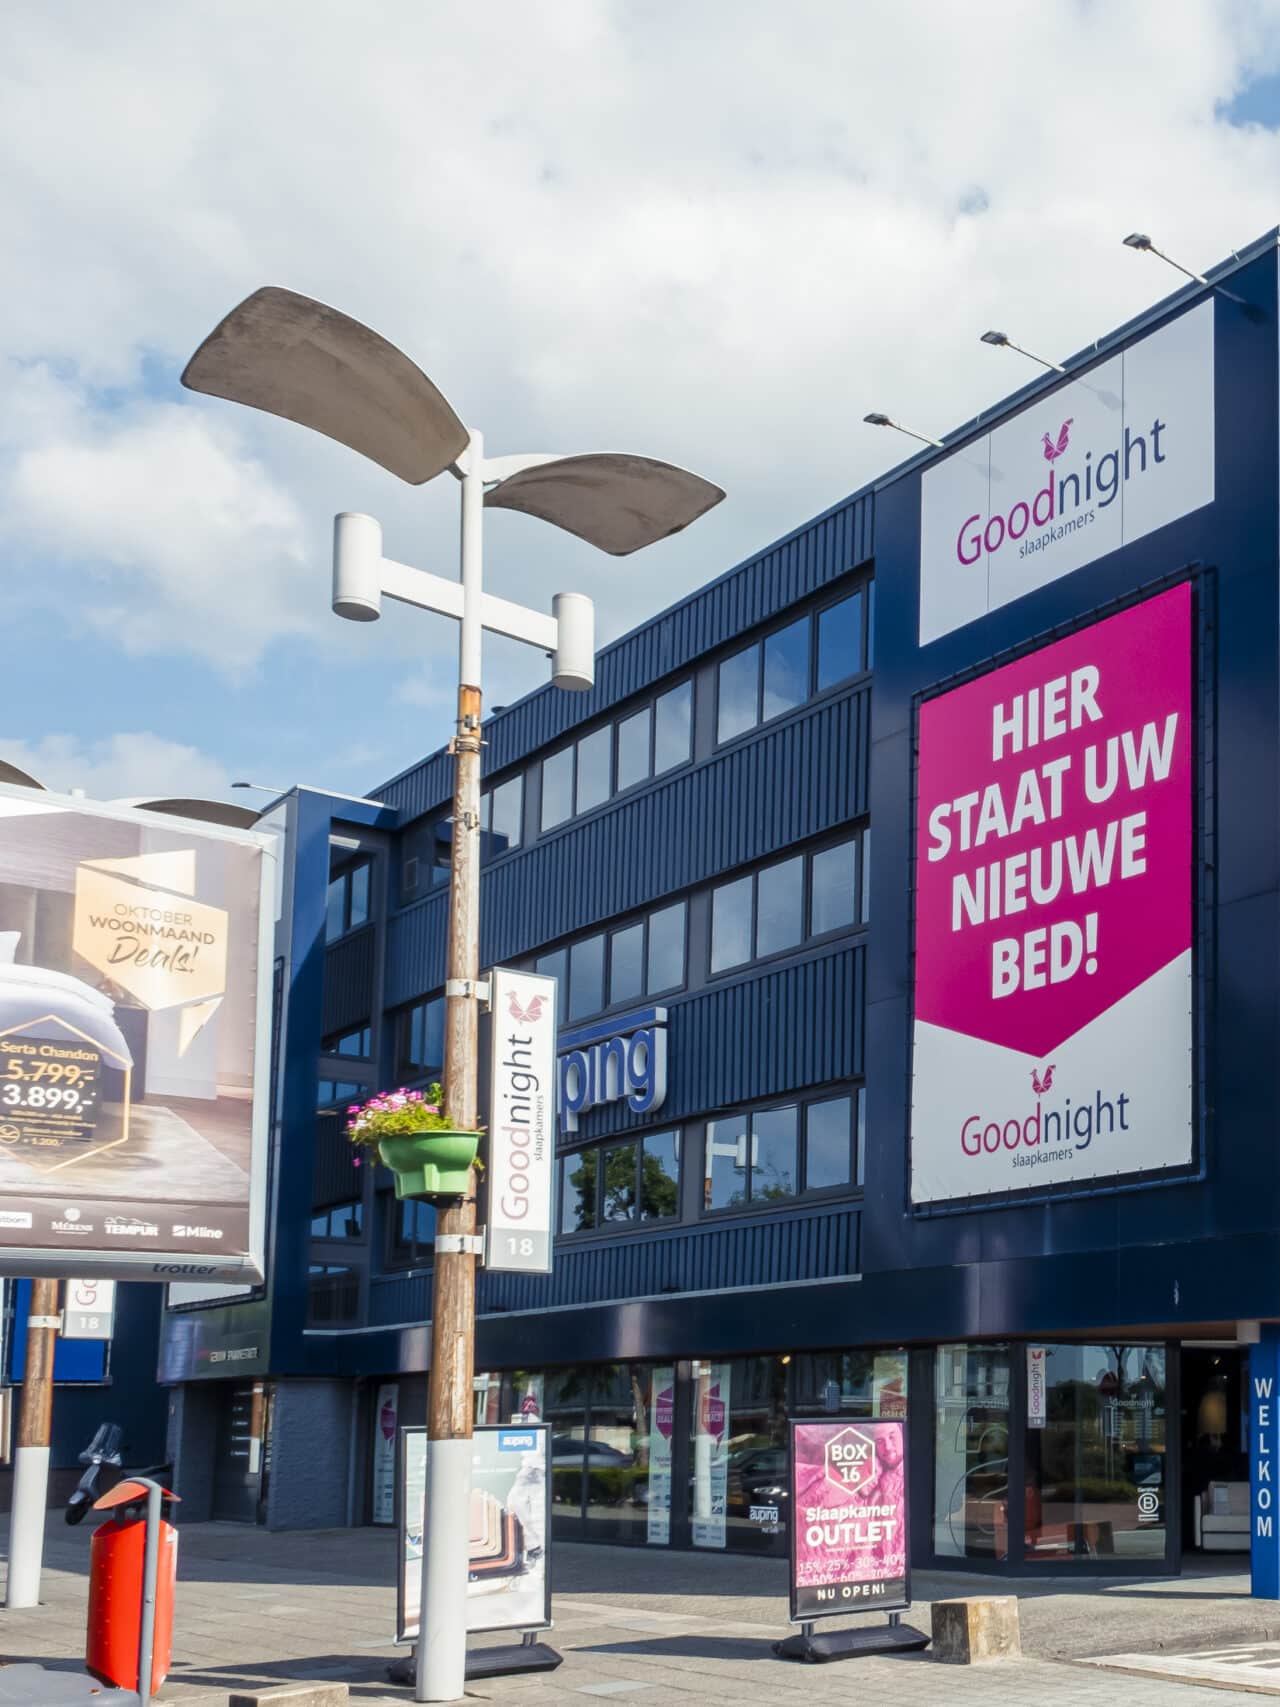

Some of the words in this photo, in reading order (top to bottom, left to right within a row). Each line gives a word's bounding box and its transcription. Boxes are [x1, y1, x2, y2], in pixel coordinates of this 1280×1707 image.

[957, 419, 1166, 566] Goodnight
[1019, 508, 1095, 559] slaapkamers
[992, 665, 1103, 761] HIER
[927, 754, 1071, 863] STAAT
[1084, 713, 1178, 805] UW
[951, 811, 1147, 932] NIEUWE
[113, 903, 193, 926] OKTOBER
[88, 914, 215, 945] WOONMAAND
[991, 913, 1099, 1000] BED!
[0, 1041, 37, 1055] Serta
[40, 1045, 99, 1062] Chandon
[501, 1034, 540, 1221] Goodnight
[534, 1094, 546, 1162] slaapkamers
[961, 1090, 1129, 1158] Goodnight
[1012, 1146, 1074, 1170] slaapkamers
[104, 1225, 159, 1237] TEMPUR
[186, 1226, 224, 1240] Mline
[506, 1237, 533, 1256] 18
[152, 1263, 217, 1276] trotter
[80, 1316, 99, 1330] 18
[831, 1444, 868, 1461] BOX
[1254, 1378, 1273, 1538] WELKOM
[841, 1467, 861, 1482] 16
[749, 1506, 779, 1524] auping
[805, 1504, 897, 1523] Slaapkamer
[806, 1520, 897, 1547] OUTLET
[817, 1588, 836, 1601] NU
[841, 1583, 886, 1597] OPEN!
